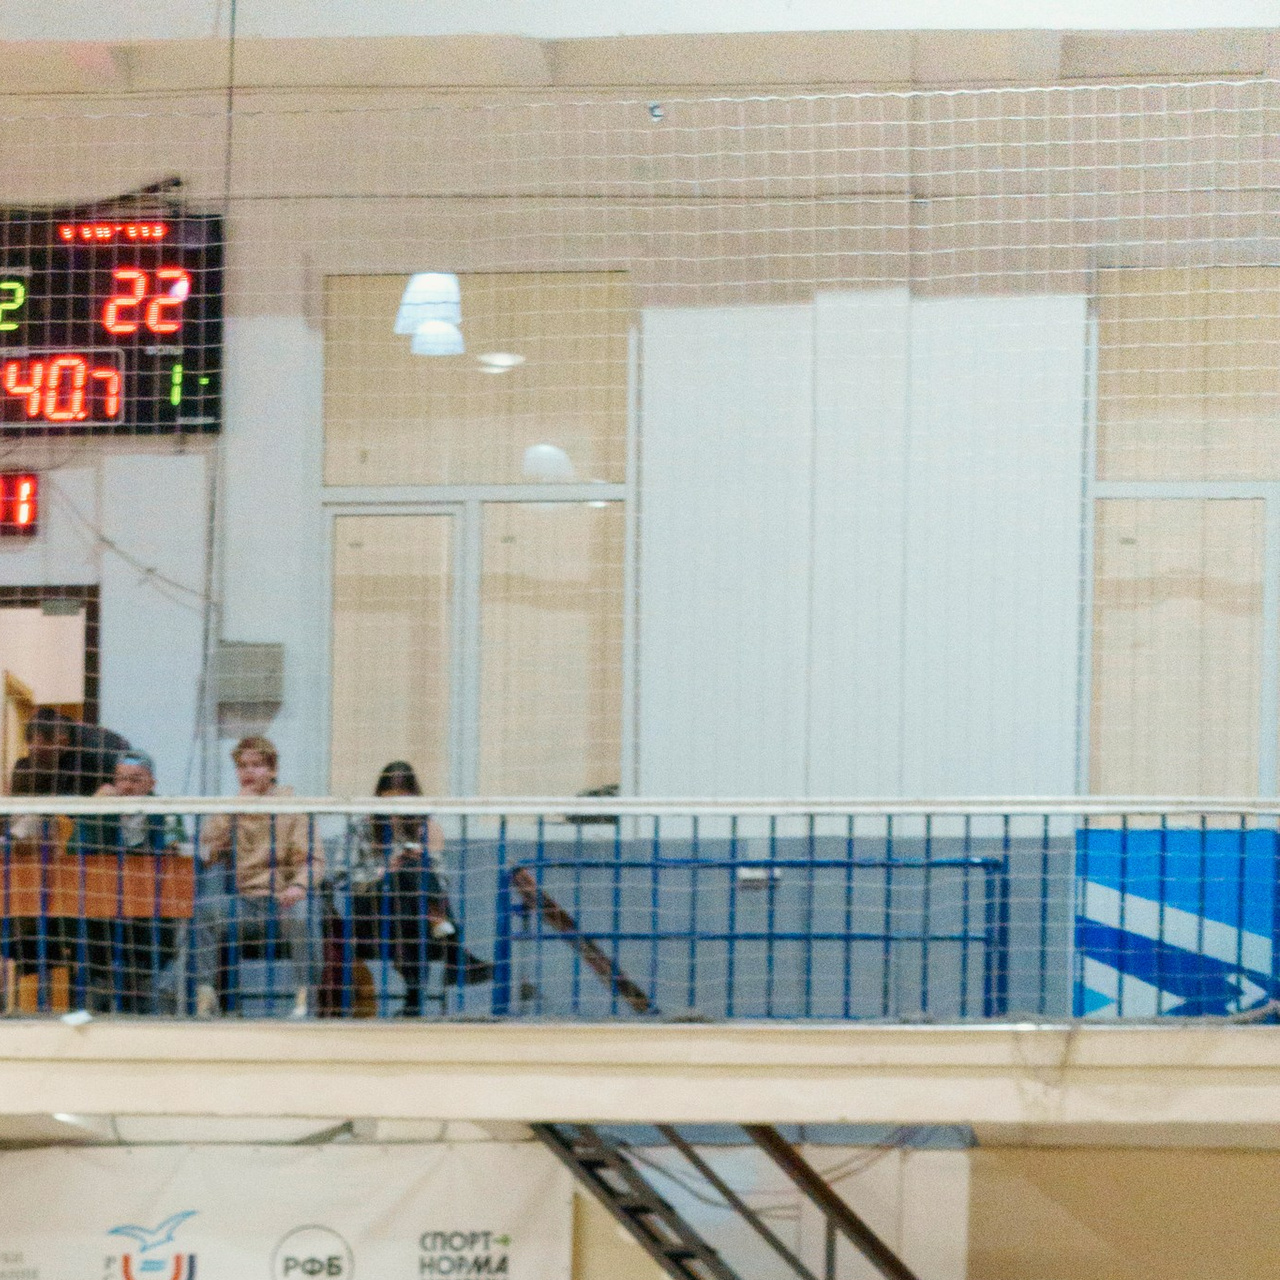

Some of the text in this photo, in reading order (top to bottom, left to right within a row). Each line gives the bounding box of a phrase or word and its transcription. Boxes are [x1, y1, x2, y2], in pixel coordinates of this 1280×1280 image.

[103, 268, 190, 334] 22
[420, 1231, 493, 1253] СПОРТ
[283, 1255, 343, 1278] РФБ
[419, 1254, 508, 1276] НОРМА
